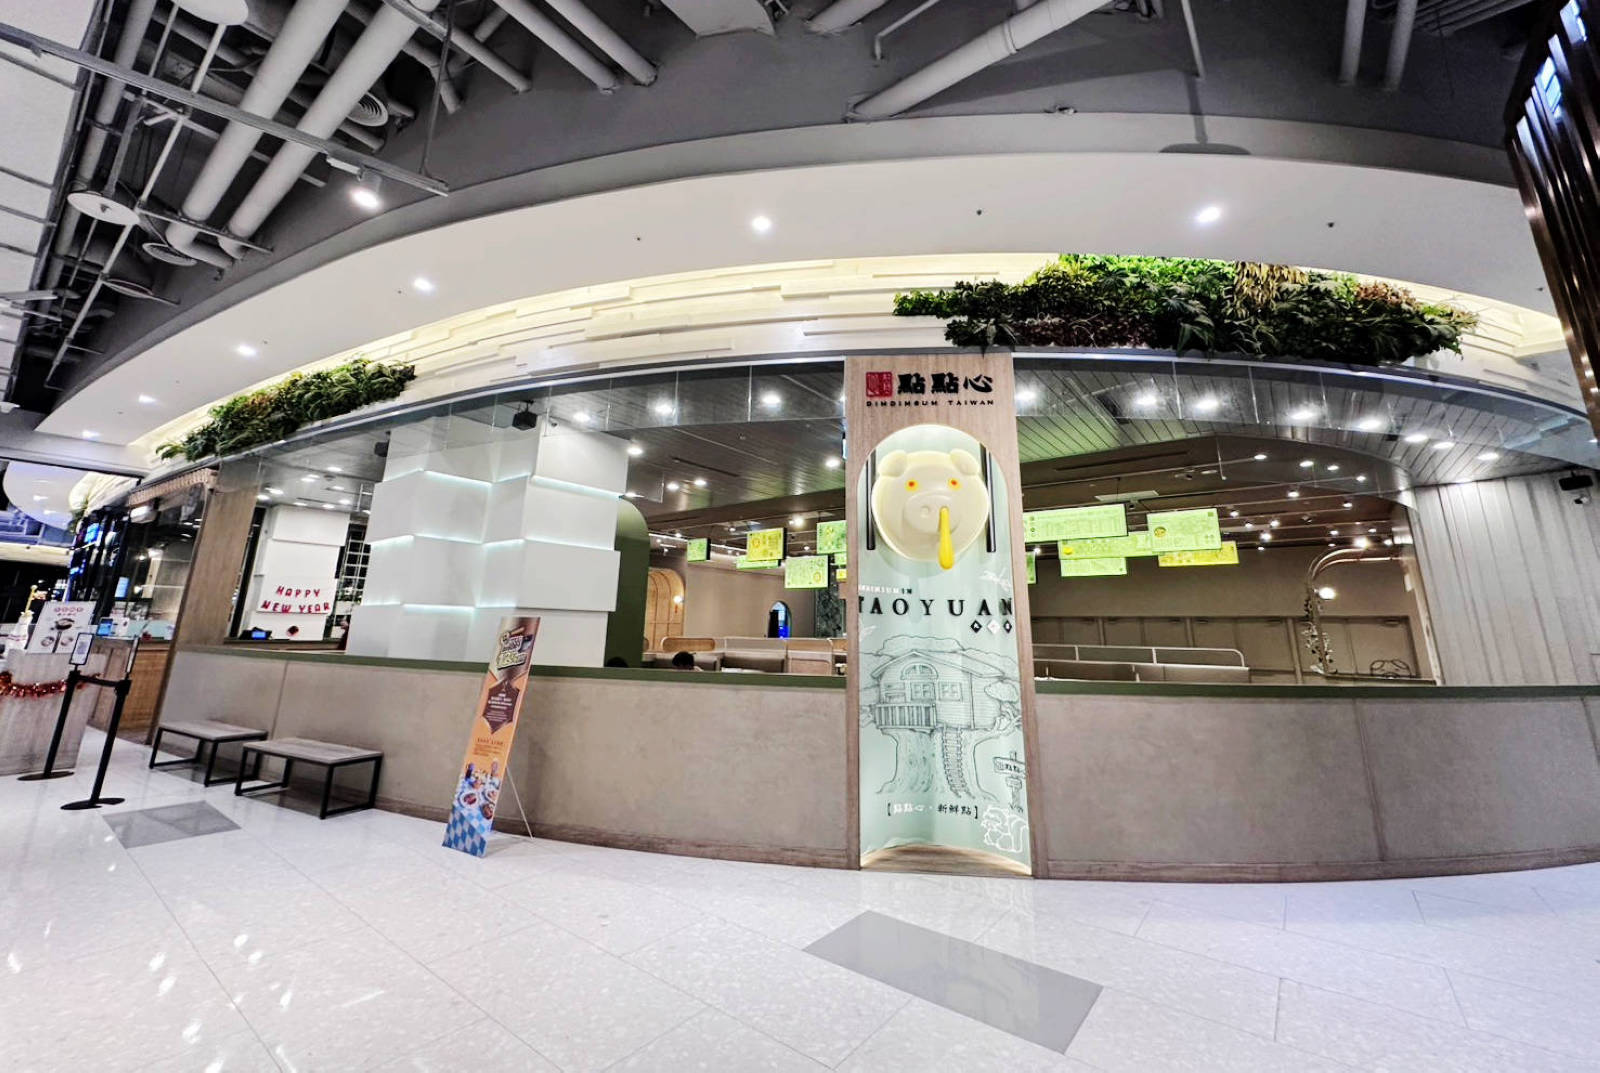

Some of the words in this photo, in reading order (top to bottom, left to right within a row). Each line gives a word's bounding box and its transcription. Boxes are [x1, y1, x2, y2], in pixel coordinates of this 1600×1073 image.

[897, 372, 993, 395] 點點心
[275, 585, 320, 598] HAPPY
[261, 600, 292, 614] NEW
[299, 602, 330, 614] YEAR
